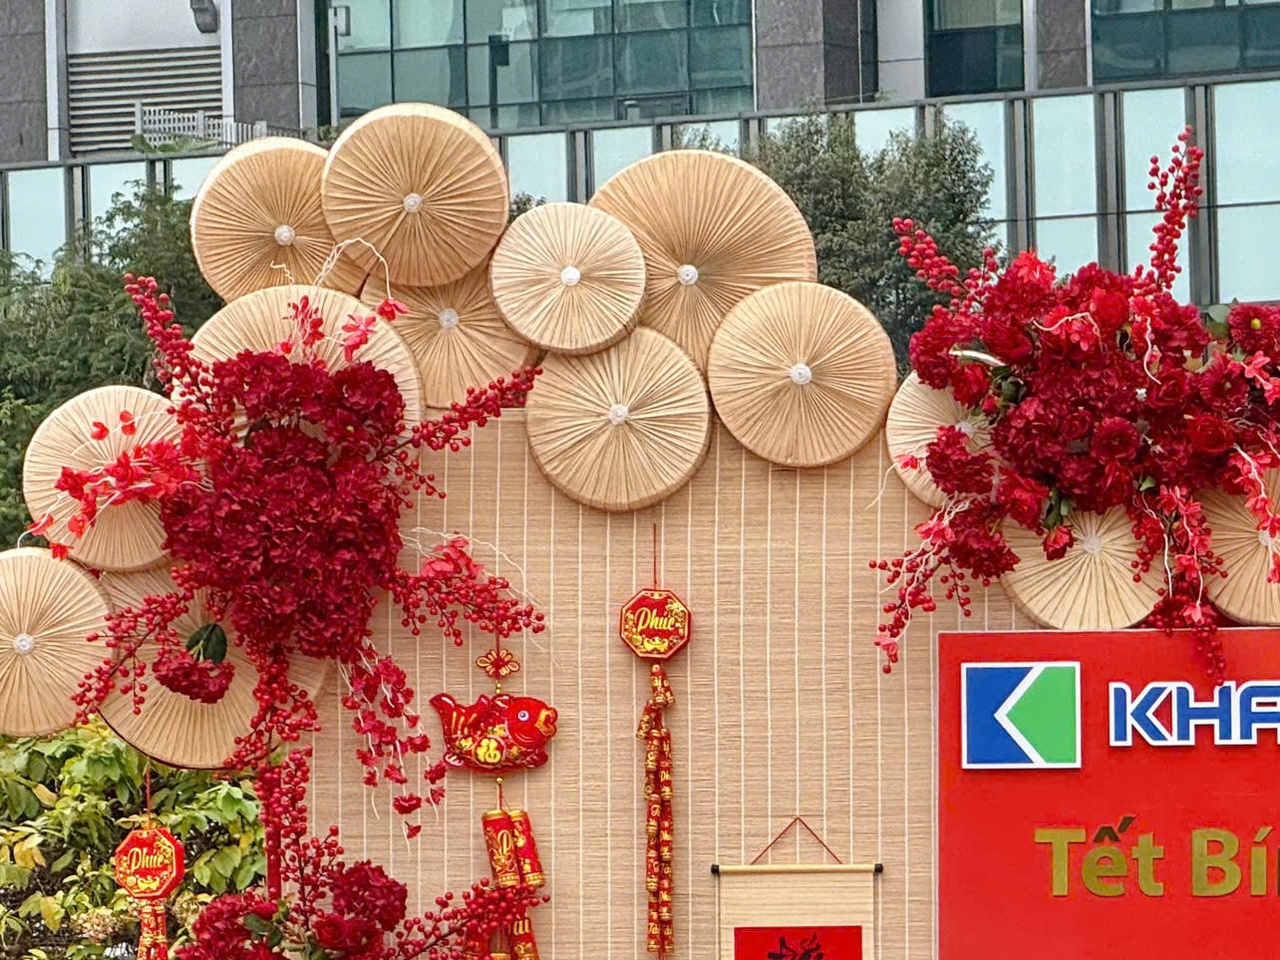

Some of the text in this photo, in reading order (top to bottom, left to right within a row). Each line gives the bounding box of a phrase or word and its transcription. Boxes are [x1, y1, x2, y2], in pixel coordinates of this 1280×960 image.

[635, 606, 675, 632] Phúc
[127, 846, 164, 873] Phúc
[1034, 816, 1165, 897] Tết
